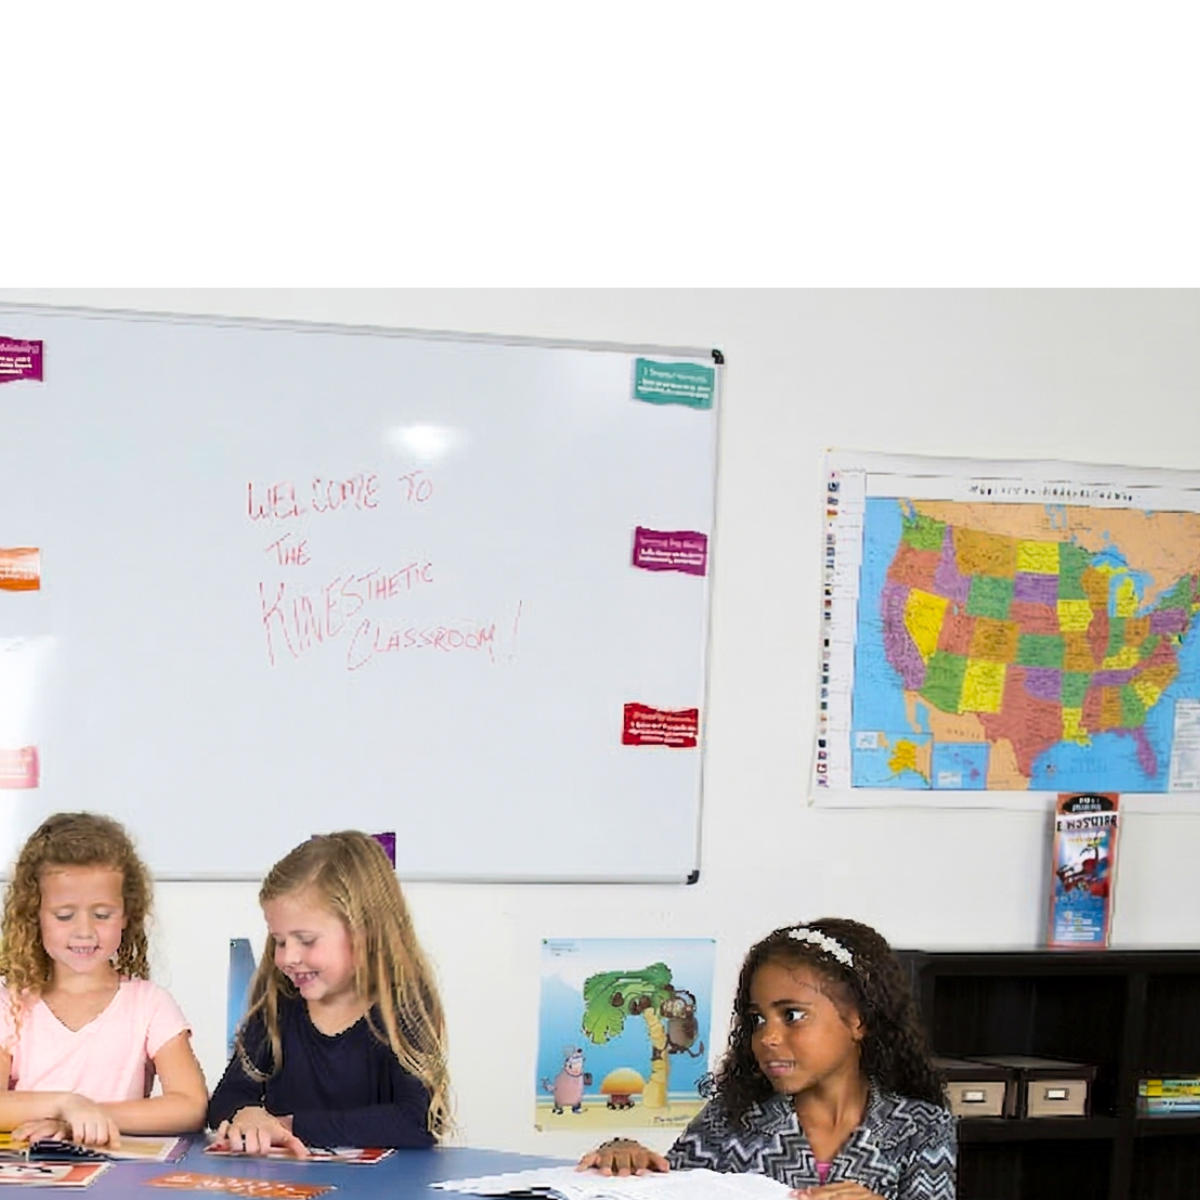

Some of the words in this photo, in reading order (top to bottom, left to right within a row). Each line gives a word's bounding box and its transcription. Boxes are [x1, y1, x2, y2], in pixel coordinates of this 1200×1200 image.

[398, 470, 434, 503] TO
[264, 532, 312, 567] THE
[258, 562, 435, 667] KINESTHETIC
